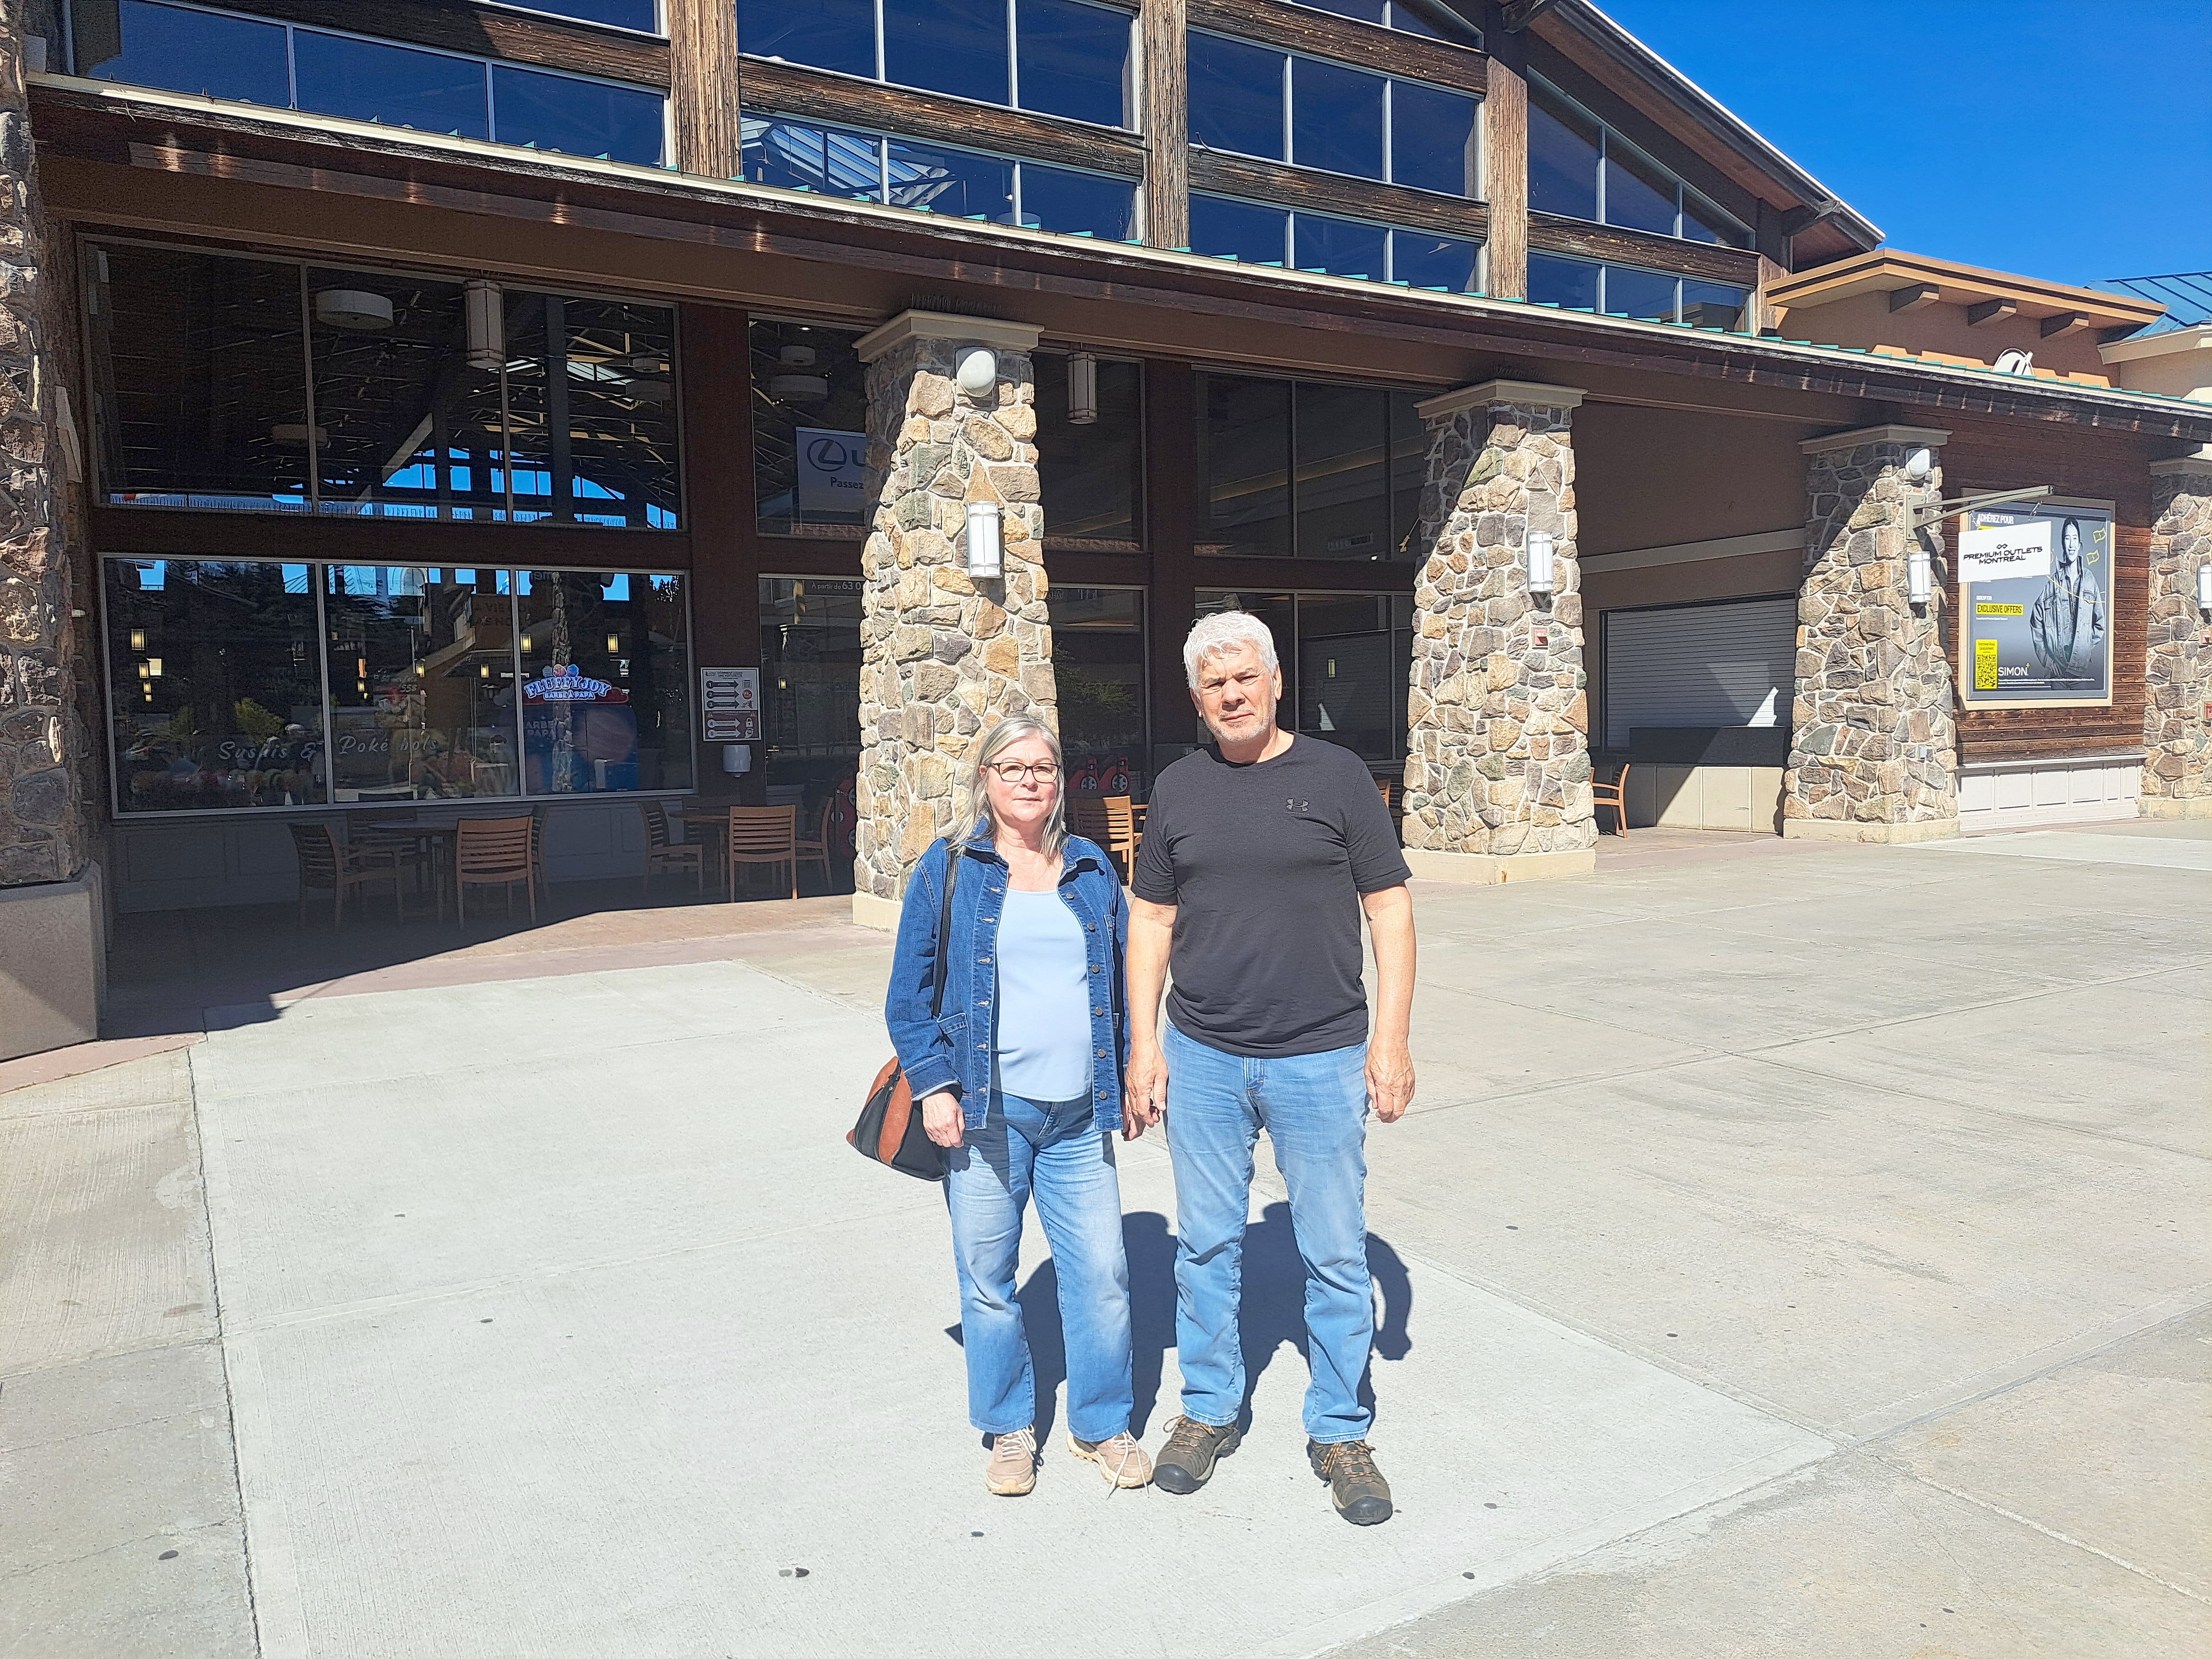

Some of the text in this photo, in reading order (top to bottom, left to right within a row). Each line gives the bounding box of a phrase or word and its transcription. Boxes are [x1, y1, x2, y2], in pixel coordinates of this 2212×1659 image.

[830, 476, 864, 490] Passez
[1978, 512, 2014, 524] ADHÉREZ POUR
[1963, 546, 2043, 561] PREMIUM OUTLETS
[842, 581, 853, 590] 63
[1977, 604, 2022, 613] EXCLUSIVE OFFERS
[339, 735, 388, 754] Poké
